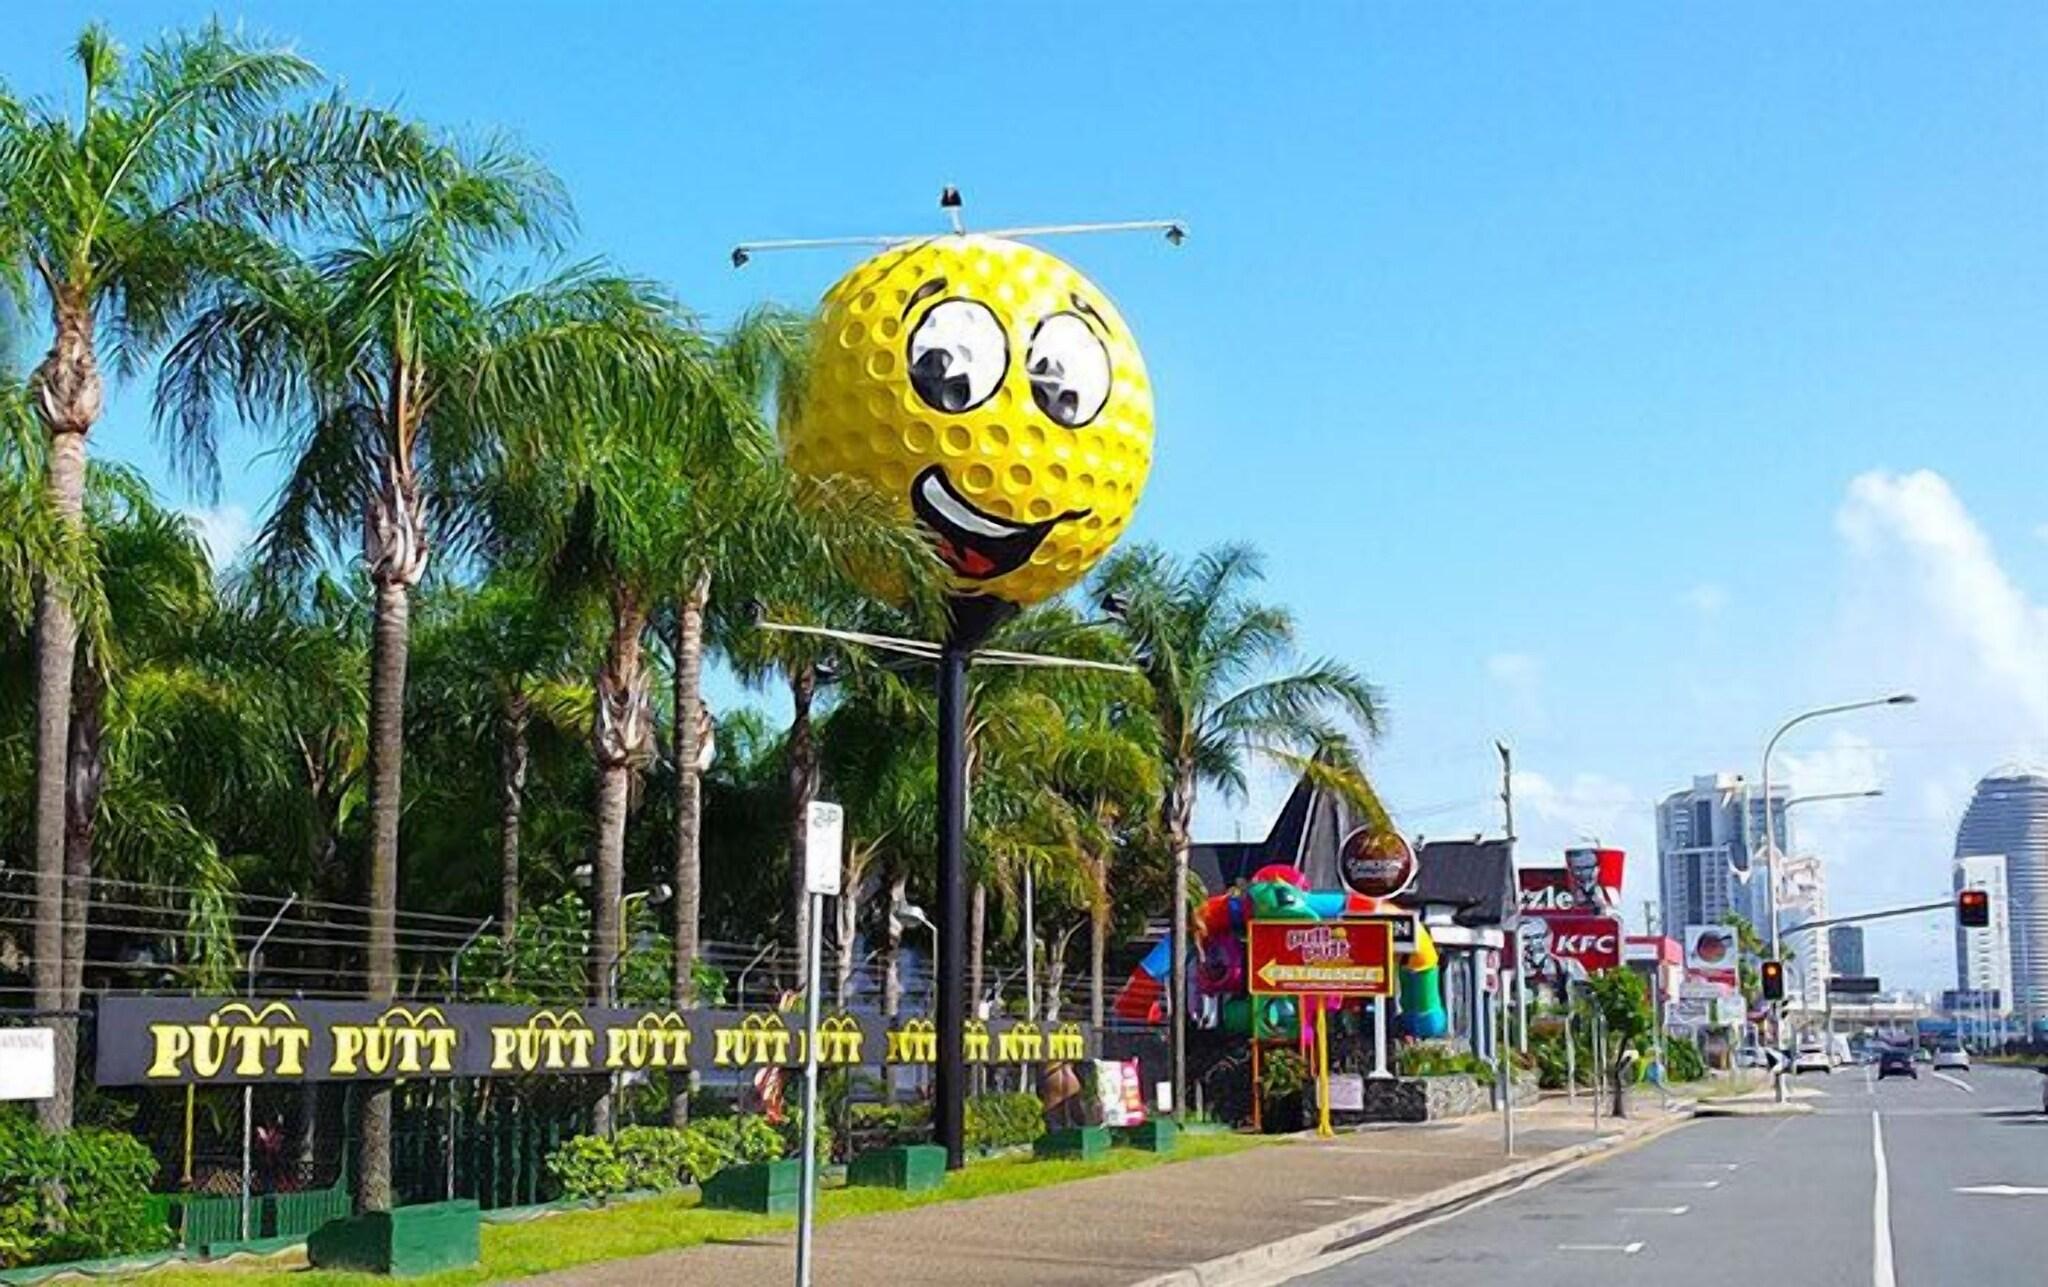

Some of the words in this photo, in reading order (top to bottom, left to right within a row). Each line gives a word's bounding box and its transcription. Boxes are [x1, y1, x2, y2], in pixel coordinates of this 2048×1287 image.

[1556, 934, 1615, 954] KFC
[147, 1010, 310, 1078] PUTT
[330, 1014, 456, 1075] PUTT
[491, 1016, 594, 1071] PUTT
[606, 1018, 692, 1068] PUTT
[714, 1020, 790, 1065] PUTT
[963, 1026, 990, 1062] TT
